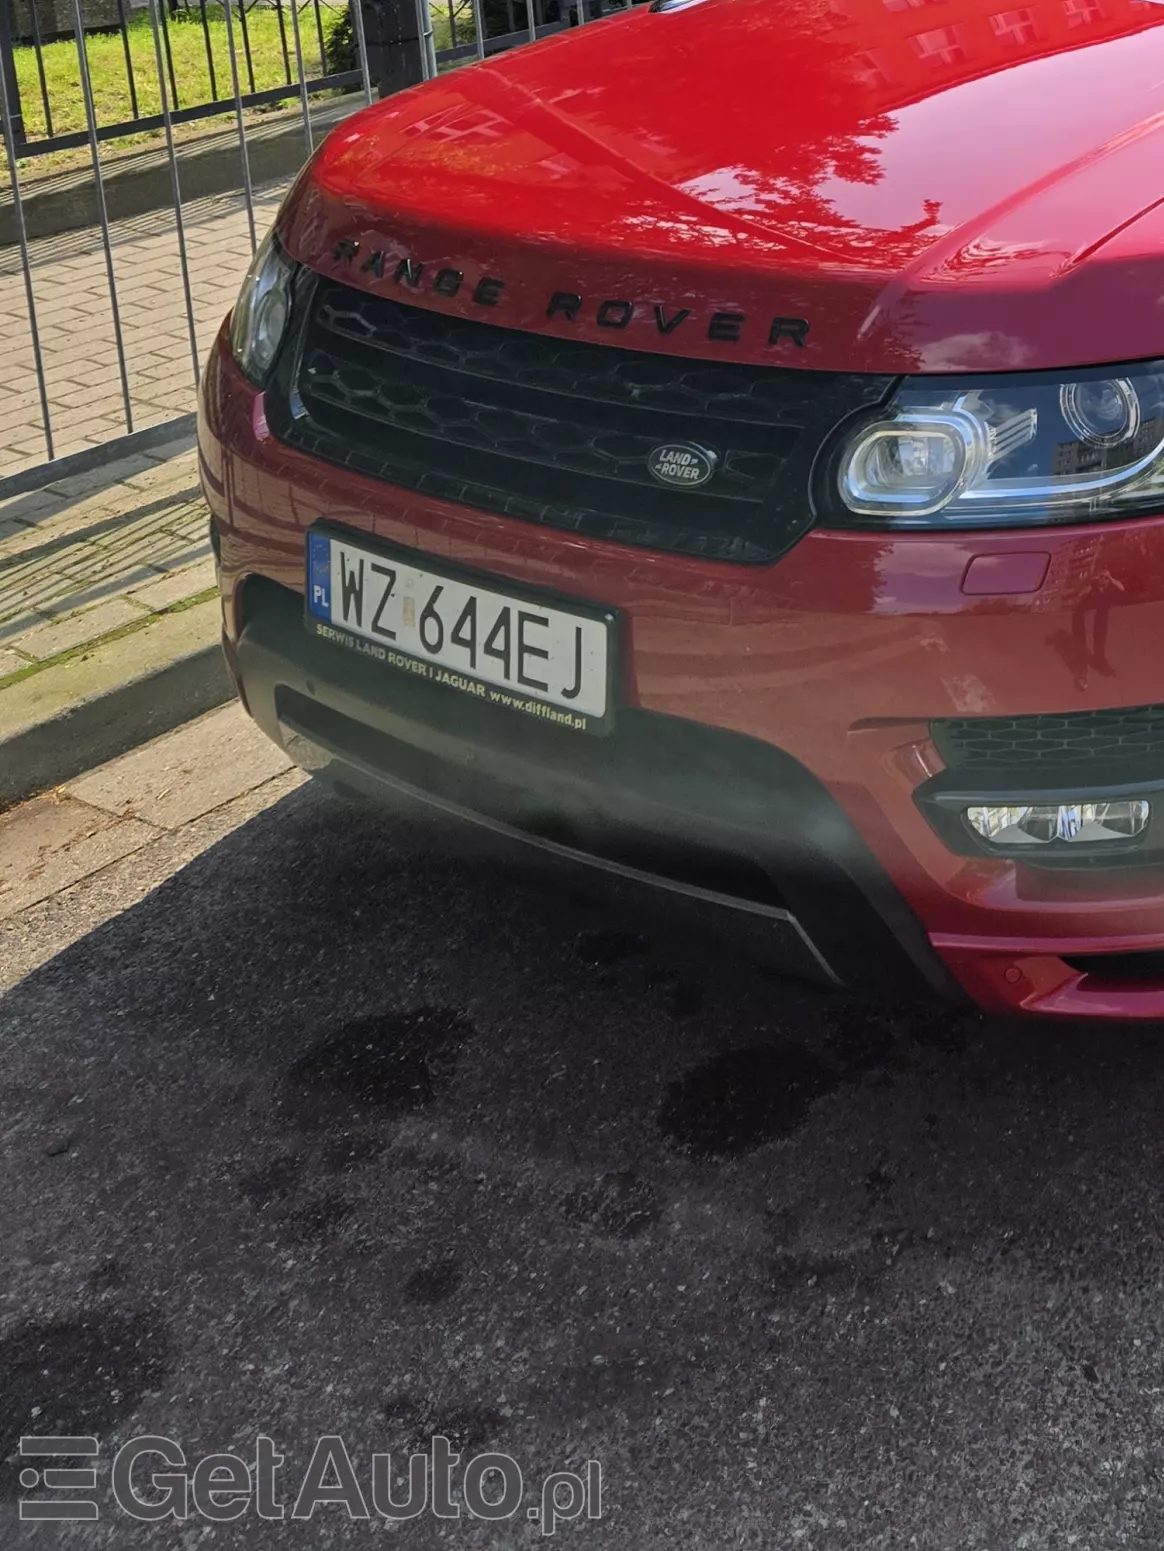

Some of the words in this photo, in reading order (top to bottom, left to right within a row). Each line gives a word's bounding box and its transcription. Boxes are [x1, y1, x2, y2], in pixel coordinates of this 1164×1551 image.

[332, 239, 506, 306] RANGE
[546, 291, 811, 347] ROVER
[660, 449, 692, 466] LAND
[660, 462, 700, 480] ROVER
[313, 585, 329, 608] PL
[340, 551, 397, 642] WZ
[419, 585, 583, 700] 644EJ
[316, 623, 355, 648] SERWIS
[356, 639, 386, 660] LAND
[388, 651, 427, 676] ROVER
[435, 670, 486, 697] JAGUAR
[489, 690, 587, 731] www.diffland.pl
